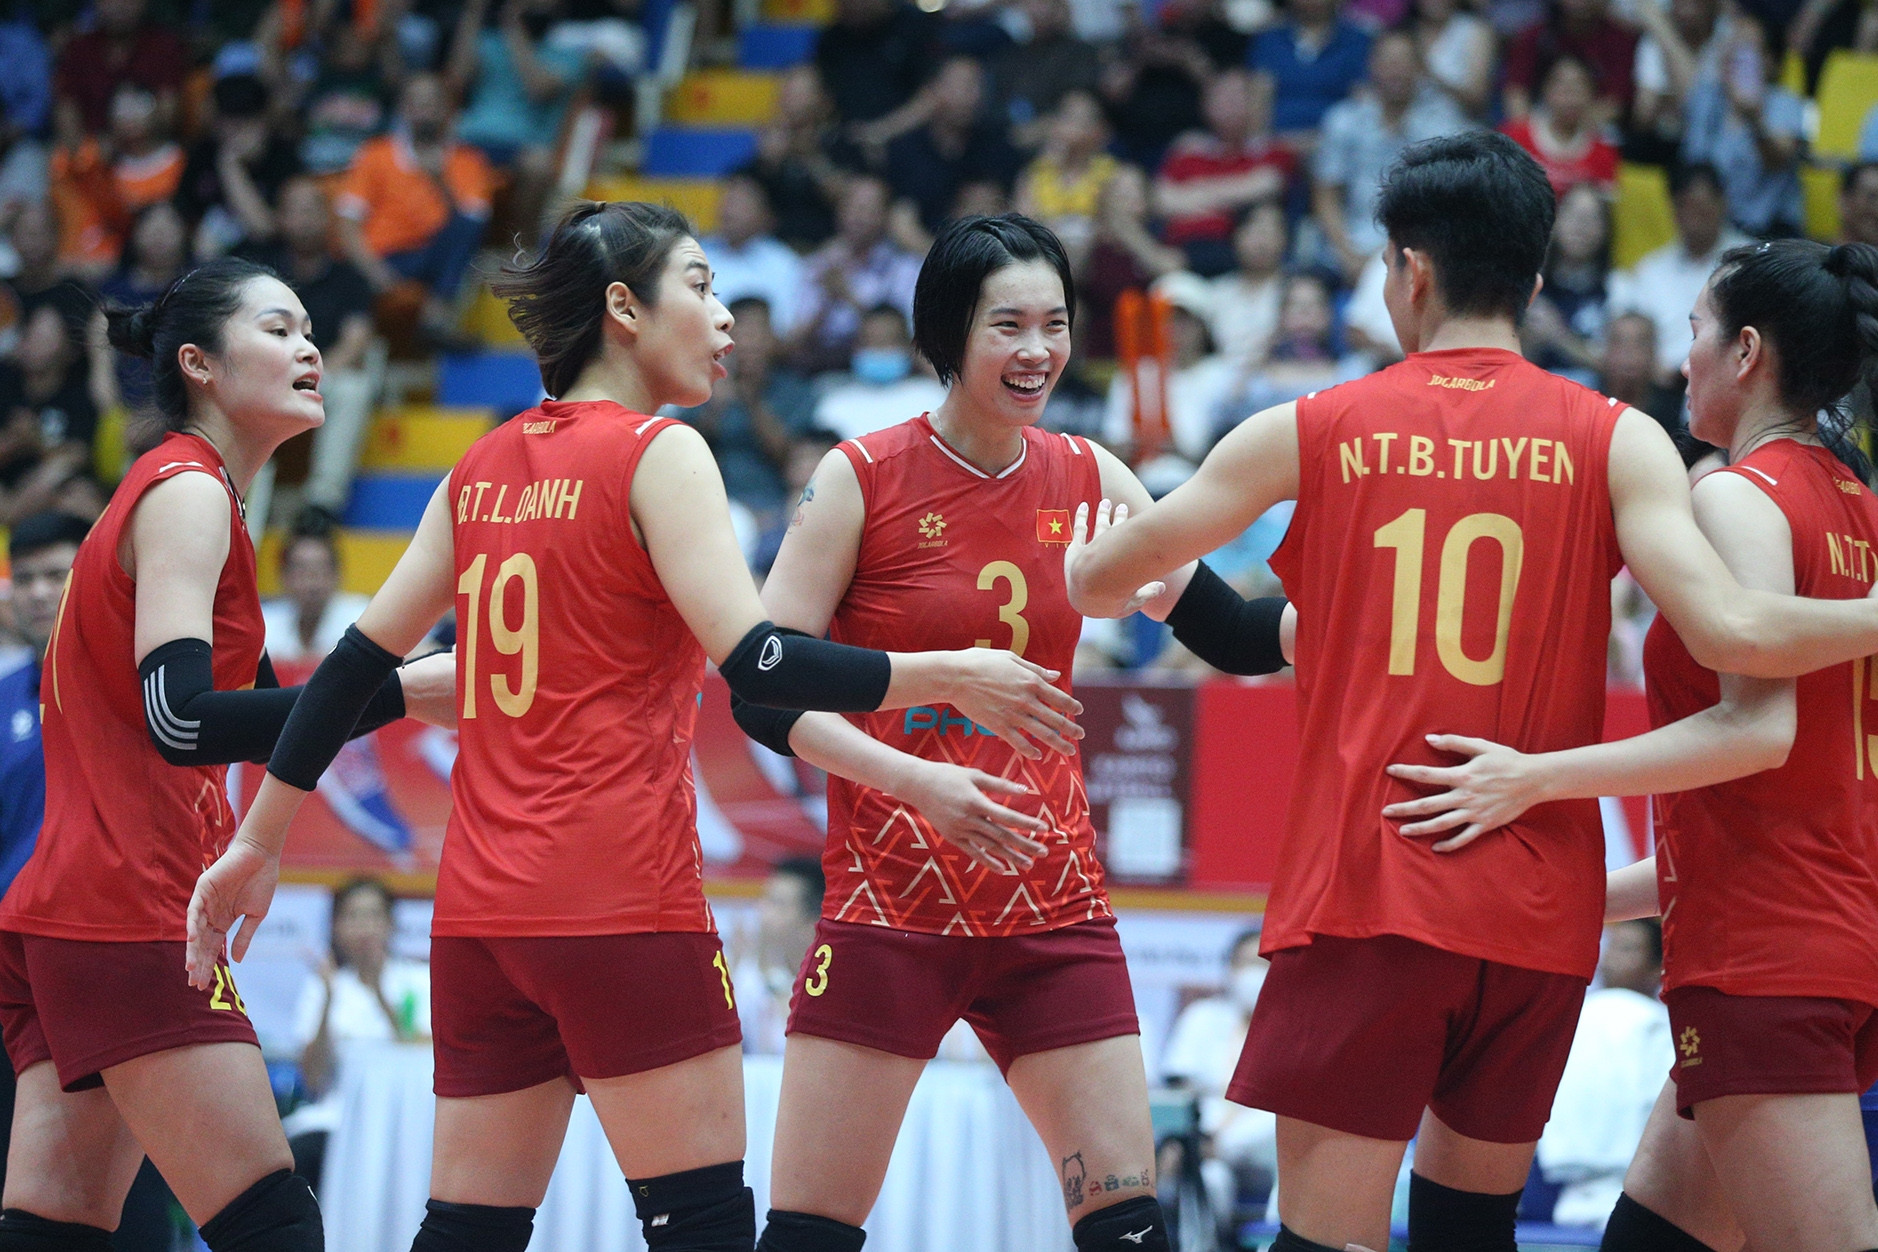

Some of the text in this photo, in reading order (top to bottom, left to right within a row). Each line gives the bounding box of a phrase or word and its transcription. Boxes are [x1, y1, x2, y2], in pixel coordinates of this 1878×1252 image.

[1339, 432, 1574, 486] N.T.B.TUYEN
[457, 552, 539, 719] 19
[974, 560, 1030, 658] 3
[1374, 507, 1524, 687] 10
[805, 944, 832, 997] 3
